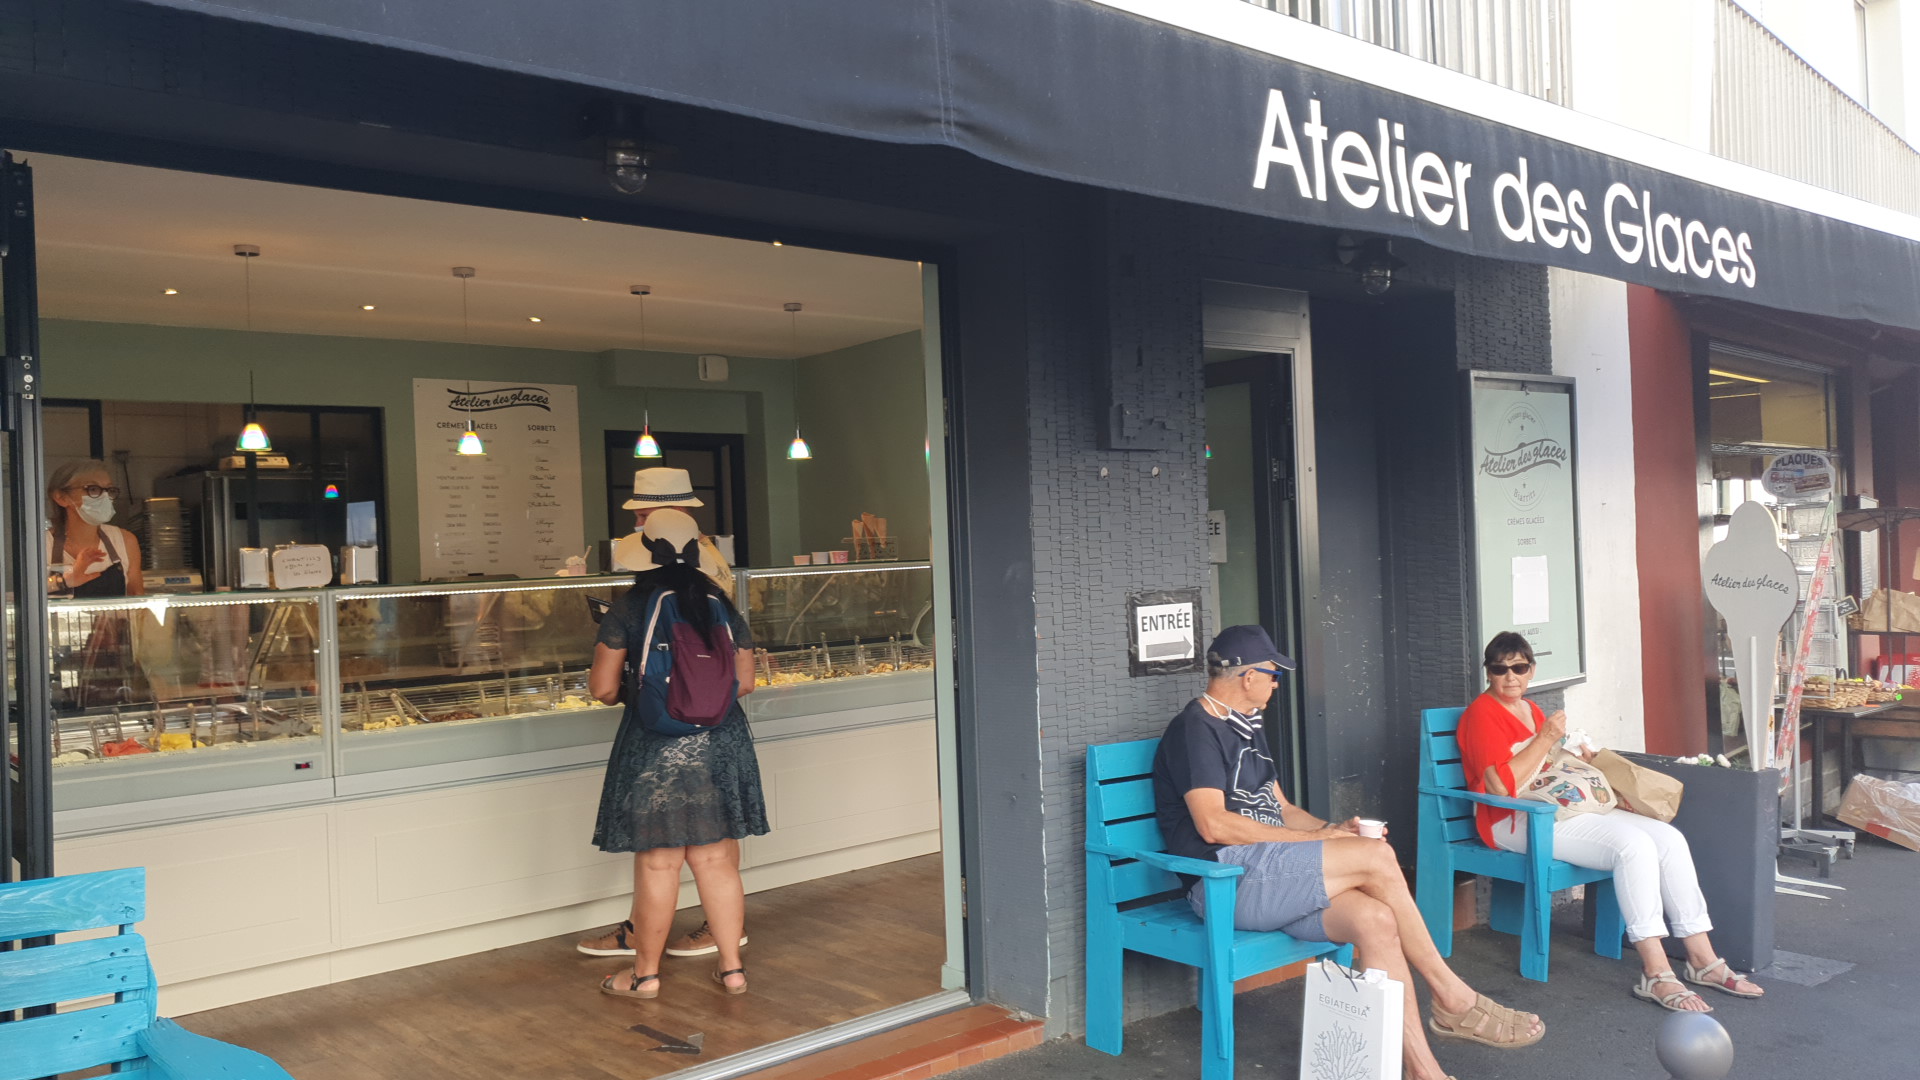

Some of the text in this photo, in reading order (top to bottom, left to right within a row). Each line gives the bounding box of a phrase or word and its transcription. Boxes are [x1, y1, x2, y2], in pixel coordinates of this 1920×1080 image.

[1253, 88, 1757, 288] Atelier des Glaces
[448, 389, 550, 408] Atelier des glaces
[527, 424, 556, 432] SORBETS
[1479, 440, 1567, 476] Atelier des glaces
[1775, 453, 1824, 467] PLAQUES
[1518, 538, 1537, 546] SORBETS
[1711, 573, 1789, 595] Atelier des glaces
[1141, 608, 1191, 633] ENTRÉE
[1319, 993, 1367, 1017] EGIATEGIA
